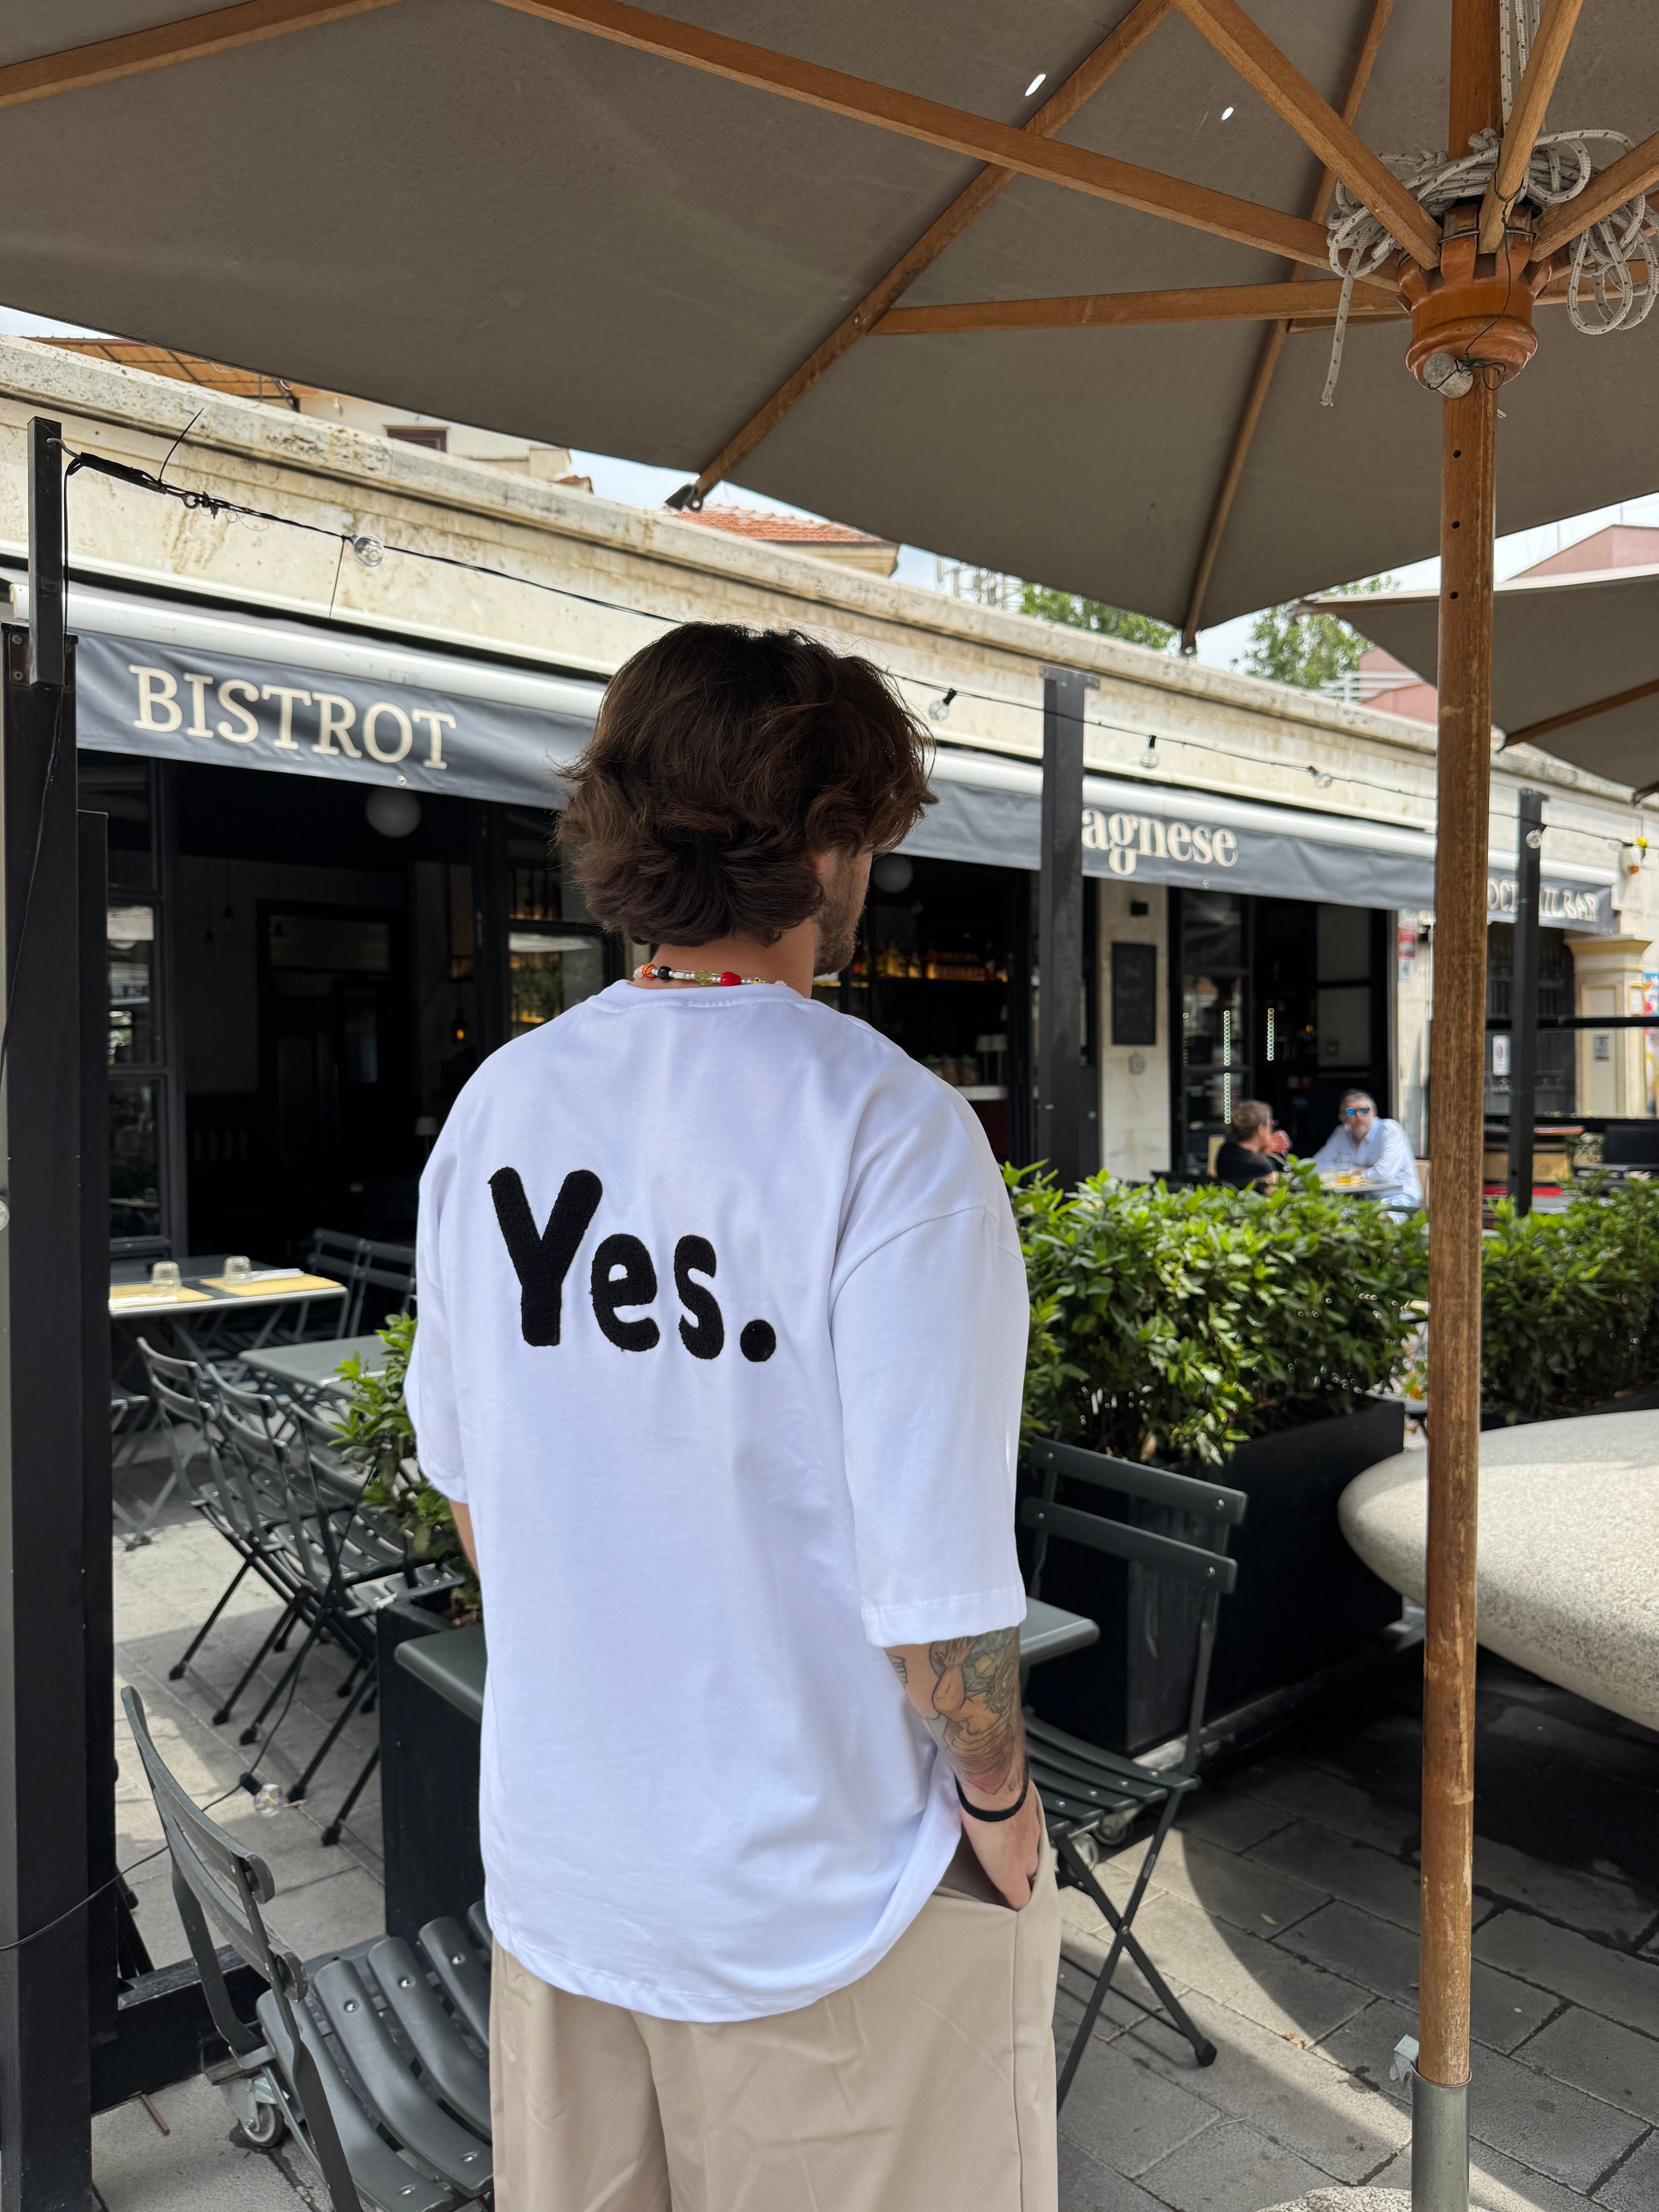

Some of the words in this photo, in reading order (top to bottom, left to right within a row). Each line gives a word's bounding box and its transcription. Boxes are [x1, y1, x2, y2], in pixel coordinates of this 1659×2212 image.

[128, 664, 457, 770] BISTROT
[1563, 890, 1600, 922] BAR
[488, 1166, 776, 1362] Yes.
